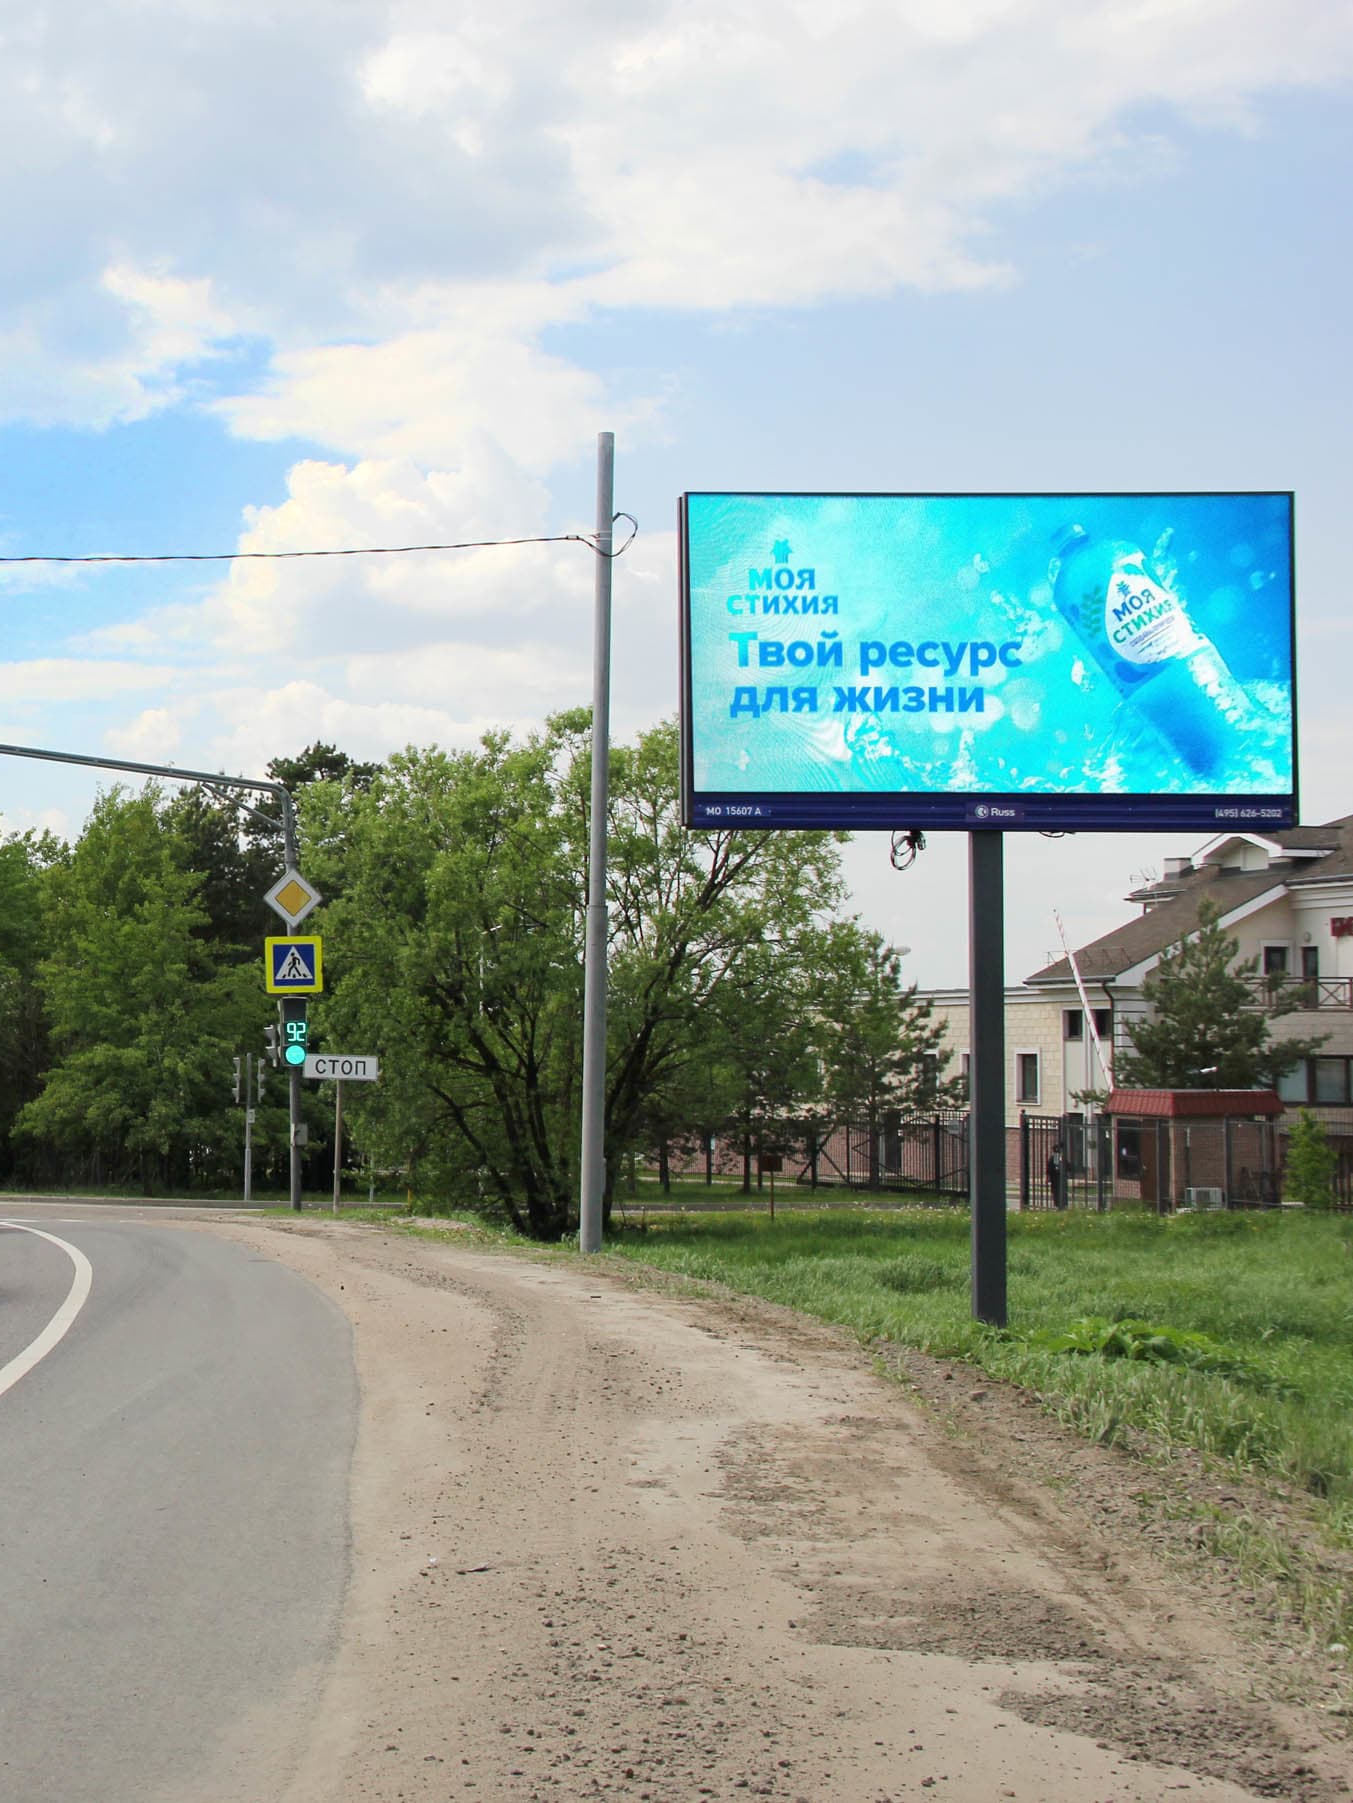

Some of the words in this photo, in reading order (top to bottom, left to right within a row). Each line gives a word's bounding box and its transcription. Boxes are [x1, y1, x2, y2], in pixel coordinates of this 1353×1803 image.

[748, 567, 816, 591] МОЯ
[726, 594, 838, 616] СТИХИЯ
[1111, 588, 1156, 622] МОЯ
[728, 629, 843, 668] Твой
[859, 640, 1024, 677] ресурс
[729, 685, 818, 718] для
[832, 685, 985, 713] жизни
[725, 806, 753, 816] 15607
[990, 807, 1015, 817] Russ
[286, 1022, 306, 1042] 92
[315, 1058, 367, 1076] СТОП
